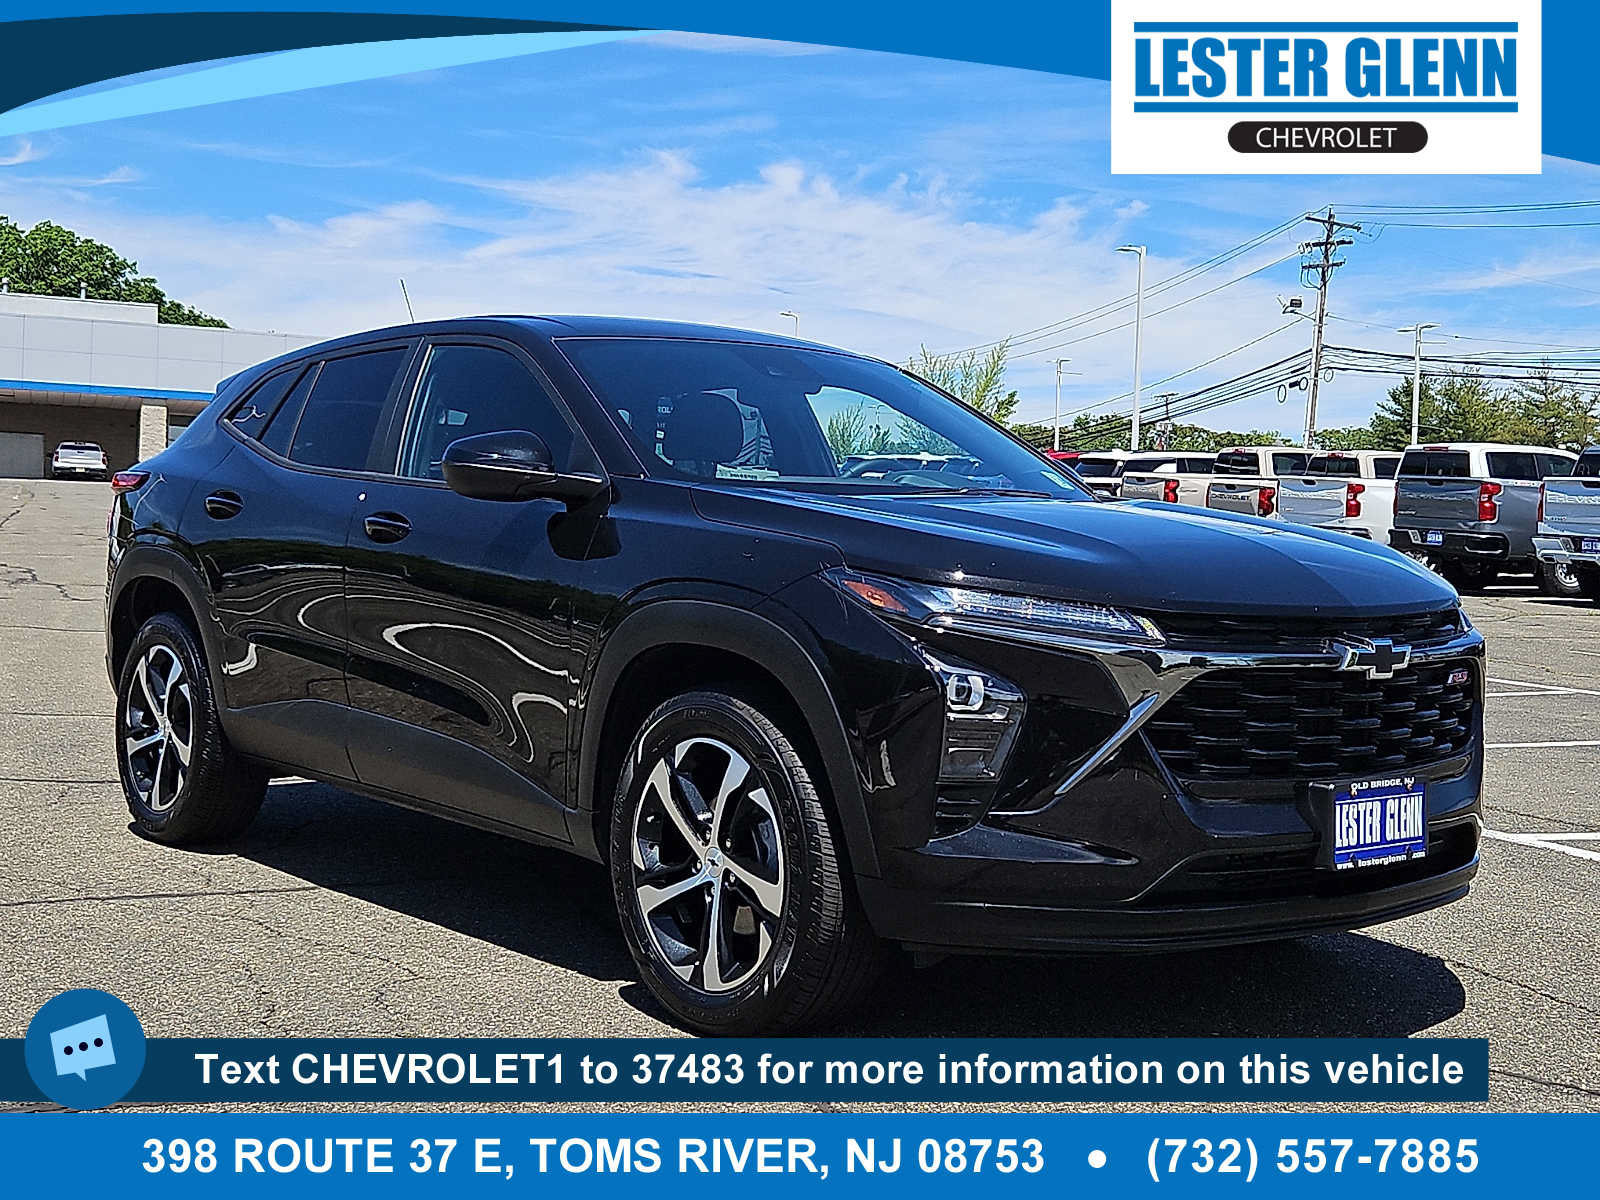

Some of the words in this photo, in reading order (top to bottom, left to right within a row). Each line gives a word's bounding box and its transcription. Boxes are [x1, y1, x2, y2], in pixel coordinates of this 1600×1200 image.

[1350, 781, 1369, 790] OLD
[1370, 778, 1403, 789] BRIDGE,
[1404, 776, 1415, 786] NJ
[1335, 800, 1382, 849] LESTER
[1385, 795, 1423, 842] GLENN
